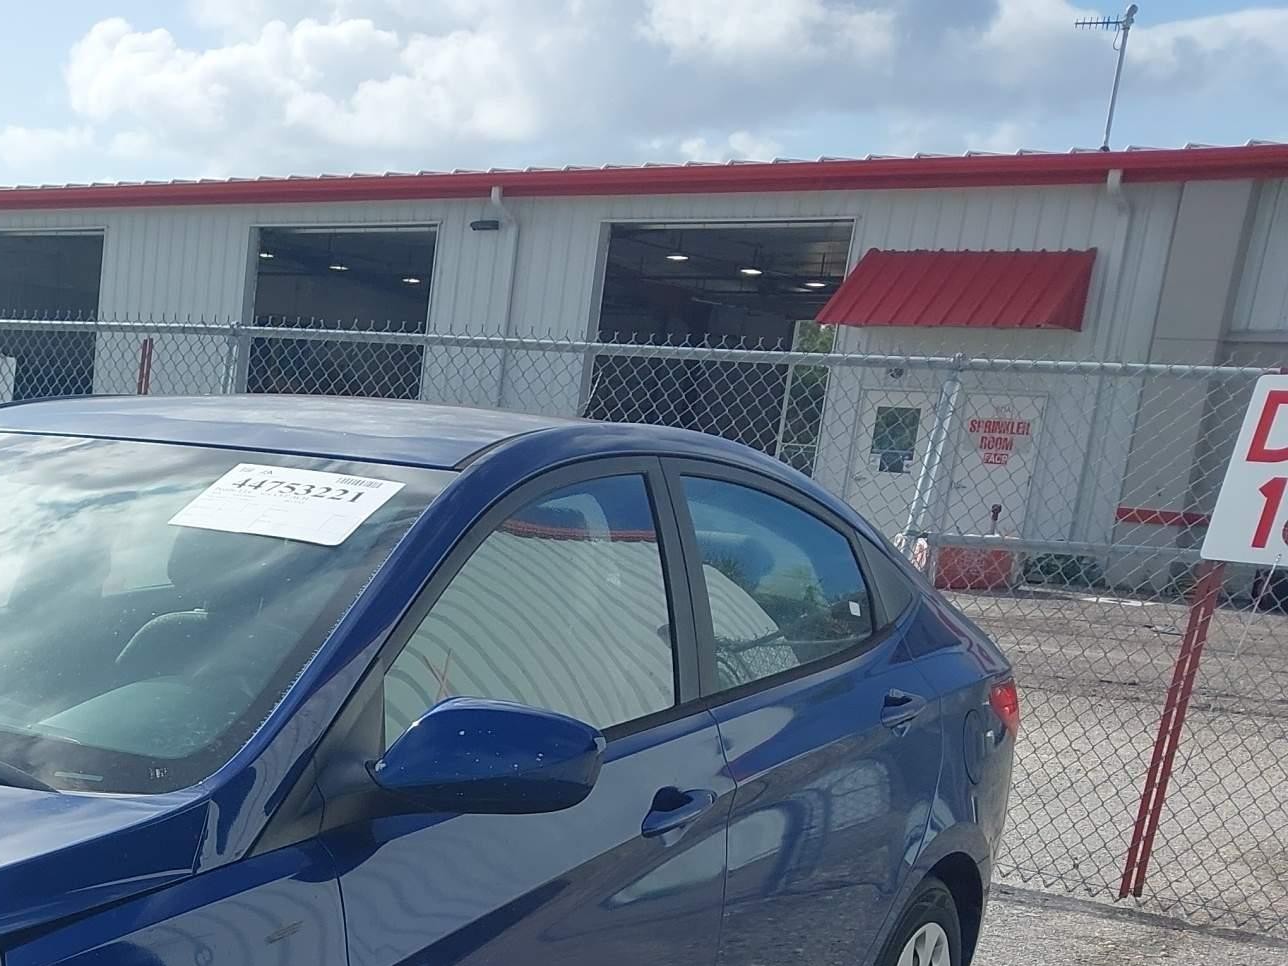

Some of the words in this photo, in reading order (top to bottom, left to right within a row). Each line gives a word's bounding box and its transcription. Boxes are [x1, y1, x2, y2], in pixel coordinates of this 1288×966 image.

[968, 418, 1031, 436] SPRINKLER
[979, 436, 1014, 451] ROOM
[232, 478, 365, 503] 44753221
[1251, 477, 1288, 549] 1
